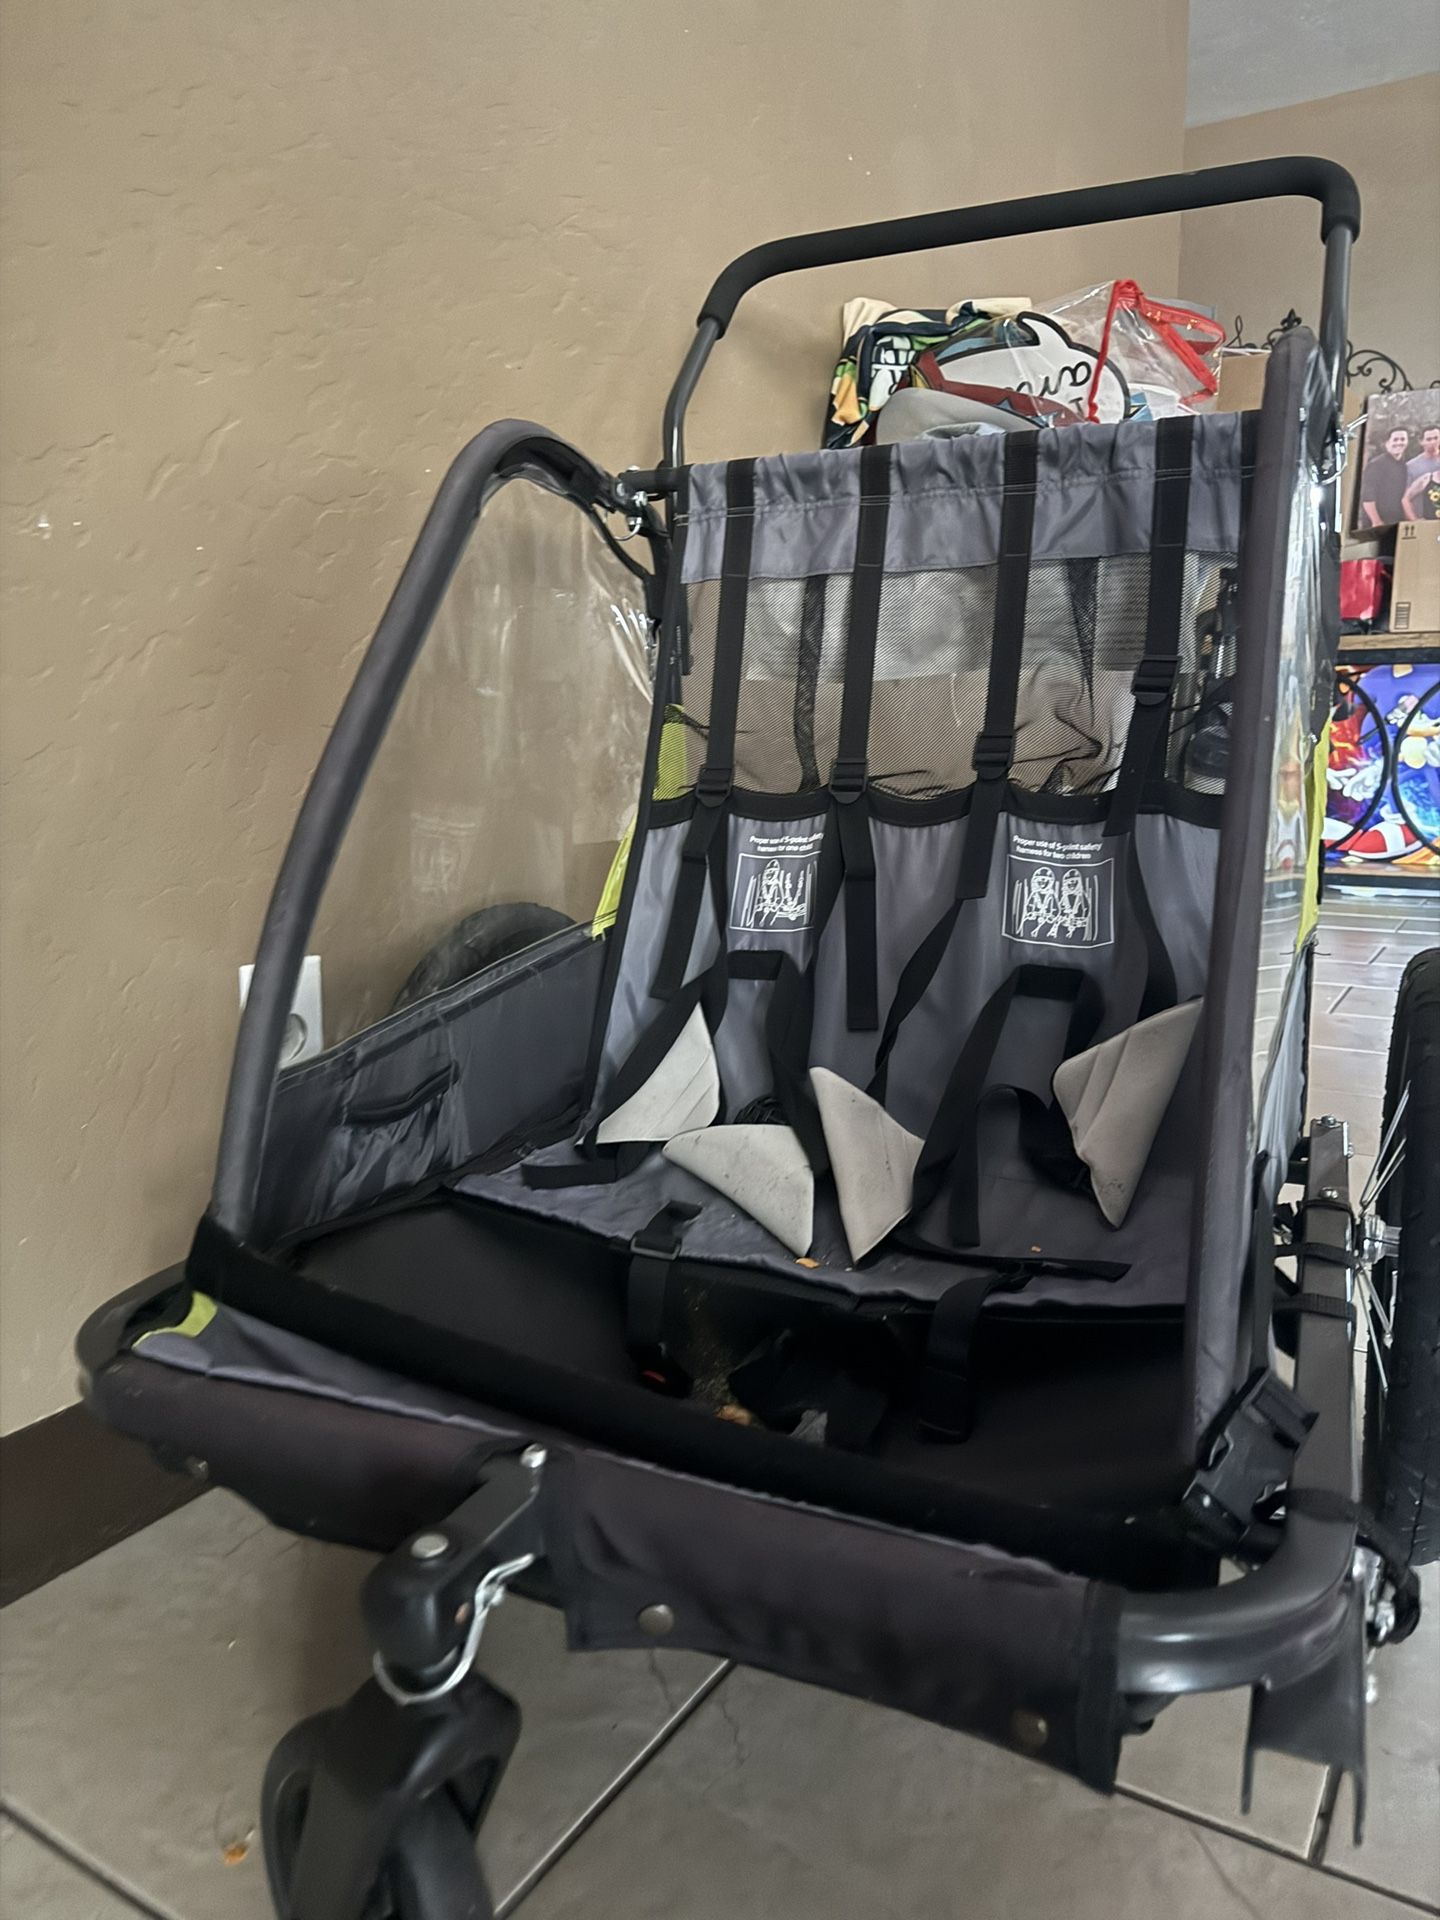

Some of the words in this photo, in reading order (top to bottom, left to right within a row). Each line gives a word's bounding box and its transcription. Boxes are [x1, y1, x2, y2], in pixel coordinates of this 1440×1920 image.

[1012, 834, 1036, 846] Proper
[1036, 840, 1048, 848] use
[1049, 841, 1056, 849] of
[1080, 843, 1103, 852] safety
[1014, 845, 1042, 856] harness
[1042, 848, 1052, 857] for
[1053, 851, 1065, 859] two
[1066, 852, 1092, 860] children
